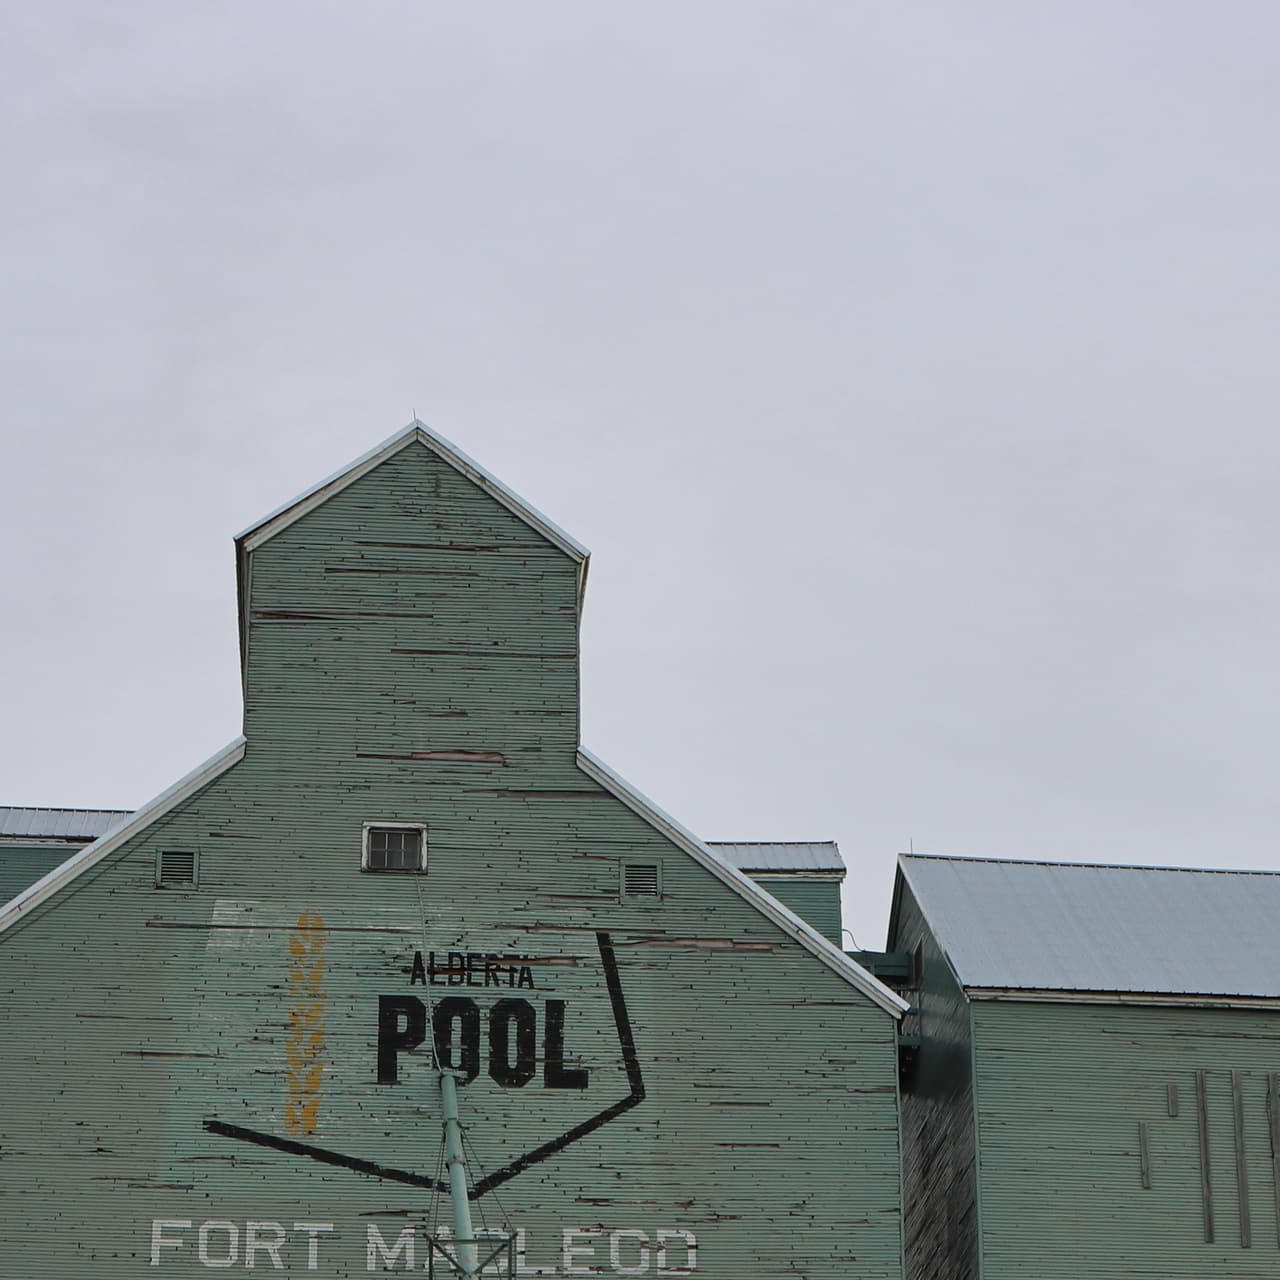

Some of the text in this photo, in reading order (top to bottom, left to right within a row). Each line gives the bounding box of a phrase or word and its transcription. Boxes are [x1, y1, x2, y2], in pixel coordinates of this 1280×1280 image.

[410, 951, 535, 989] ALBERTA
[377, 995, 588, 1088] POOL
[150, 1220, 334, 1269] FORT
